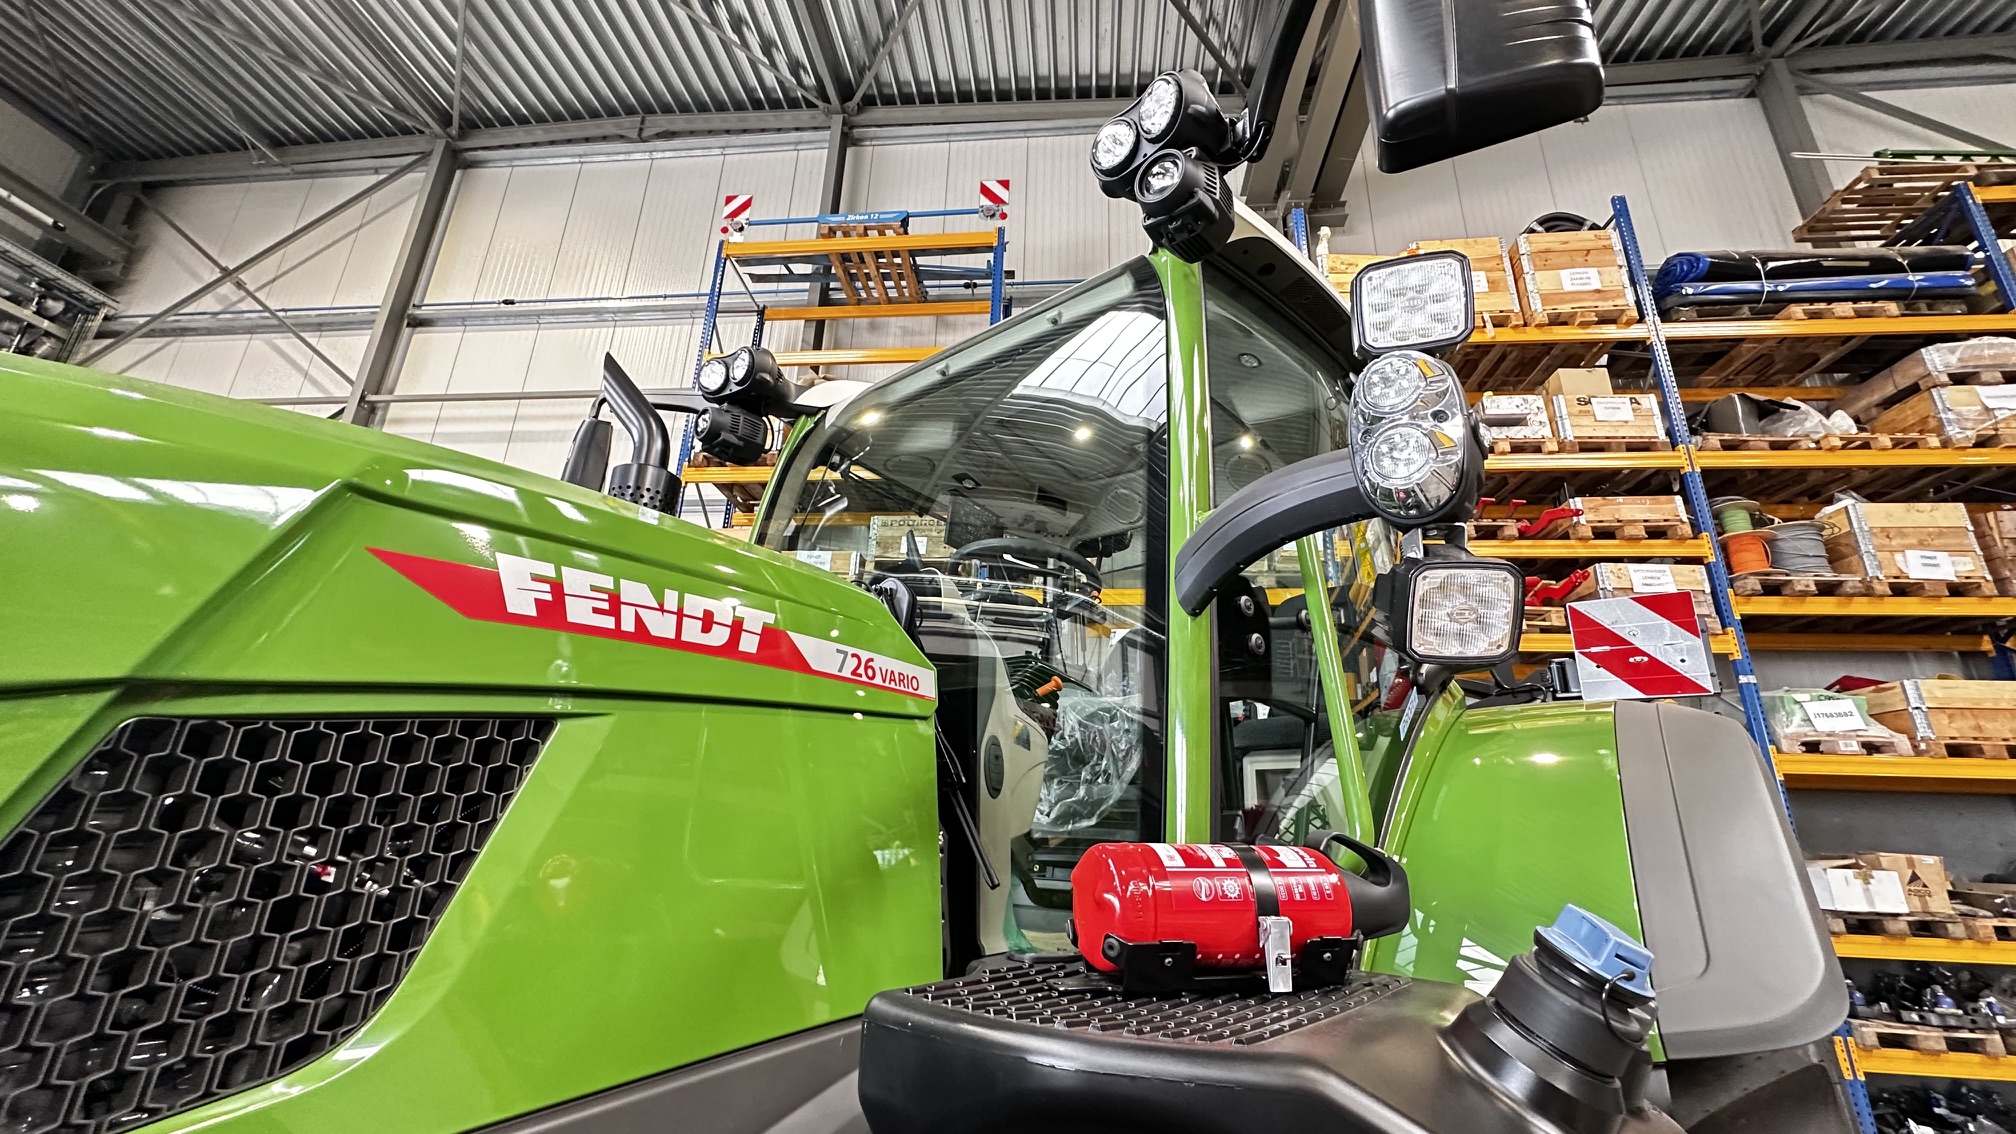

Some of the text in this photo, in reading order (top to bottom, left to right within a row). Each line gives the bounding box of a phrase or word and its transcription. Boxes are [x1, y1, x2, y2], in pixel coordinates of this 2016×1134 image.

[496, 551, 776, 654] FENDT
[835, 648, 920, 692] 726 VARIO
